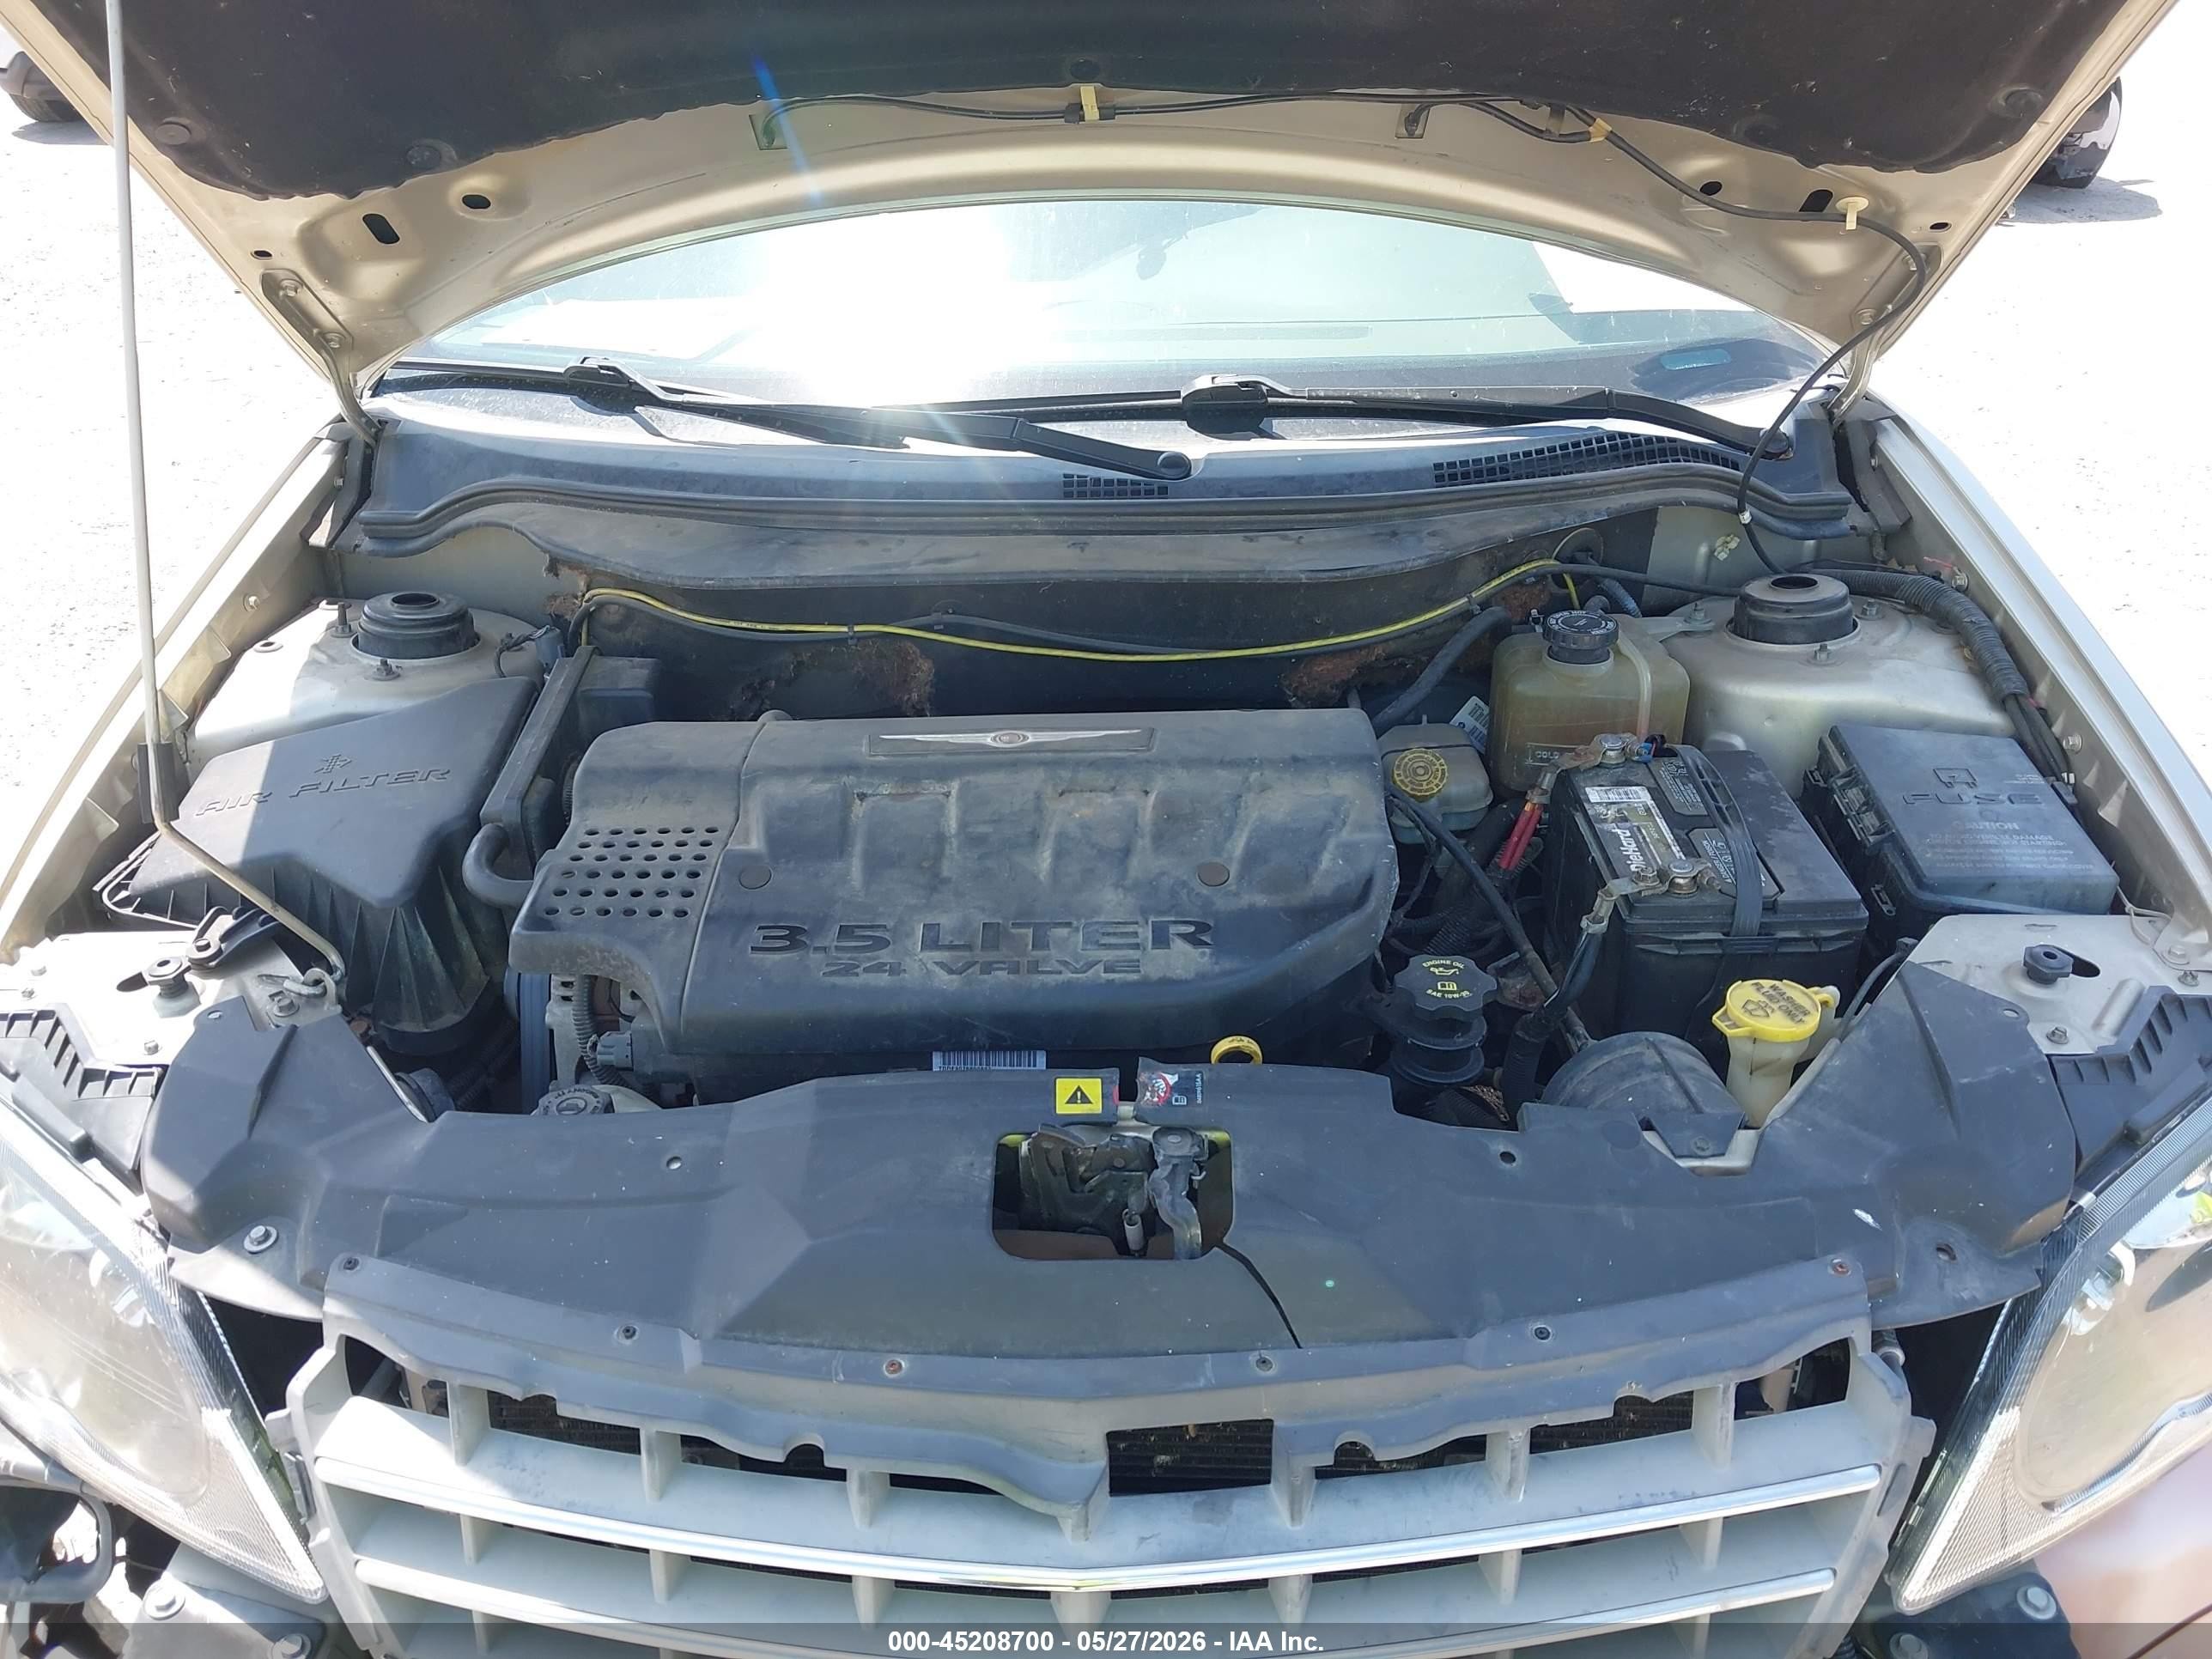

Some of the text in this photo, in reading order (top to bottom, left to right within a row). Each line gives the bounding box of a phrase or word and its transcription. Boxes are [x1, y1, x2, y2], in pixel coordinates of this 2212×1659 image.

[1535, 750, 1560, 759] COLD
[196, 769, 451, 816] AIR FILTER
[1902, 792, 2043, 805] FUSE
[1612, 827, 1648, 872] DieHard
[750, 919, 1213, 955] 3.5 LITER
[821, 958, 1142, 977] 24 VALVE
[1422, 959, 1465, 969] ENGINE OIL
[1425, 988, 1443, 998] SAE
[1752, 981, 1806, 1024] FLUID ONLY
[1769, 983, 1811, 1017] WASHER
